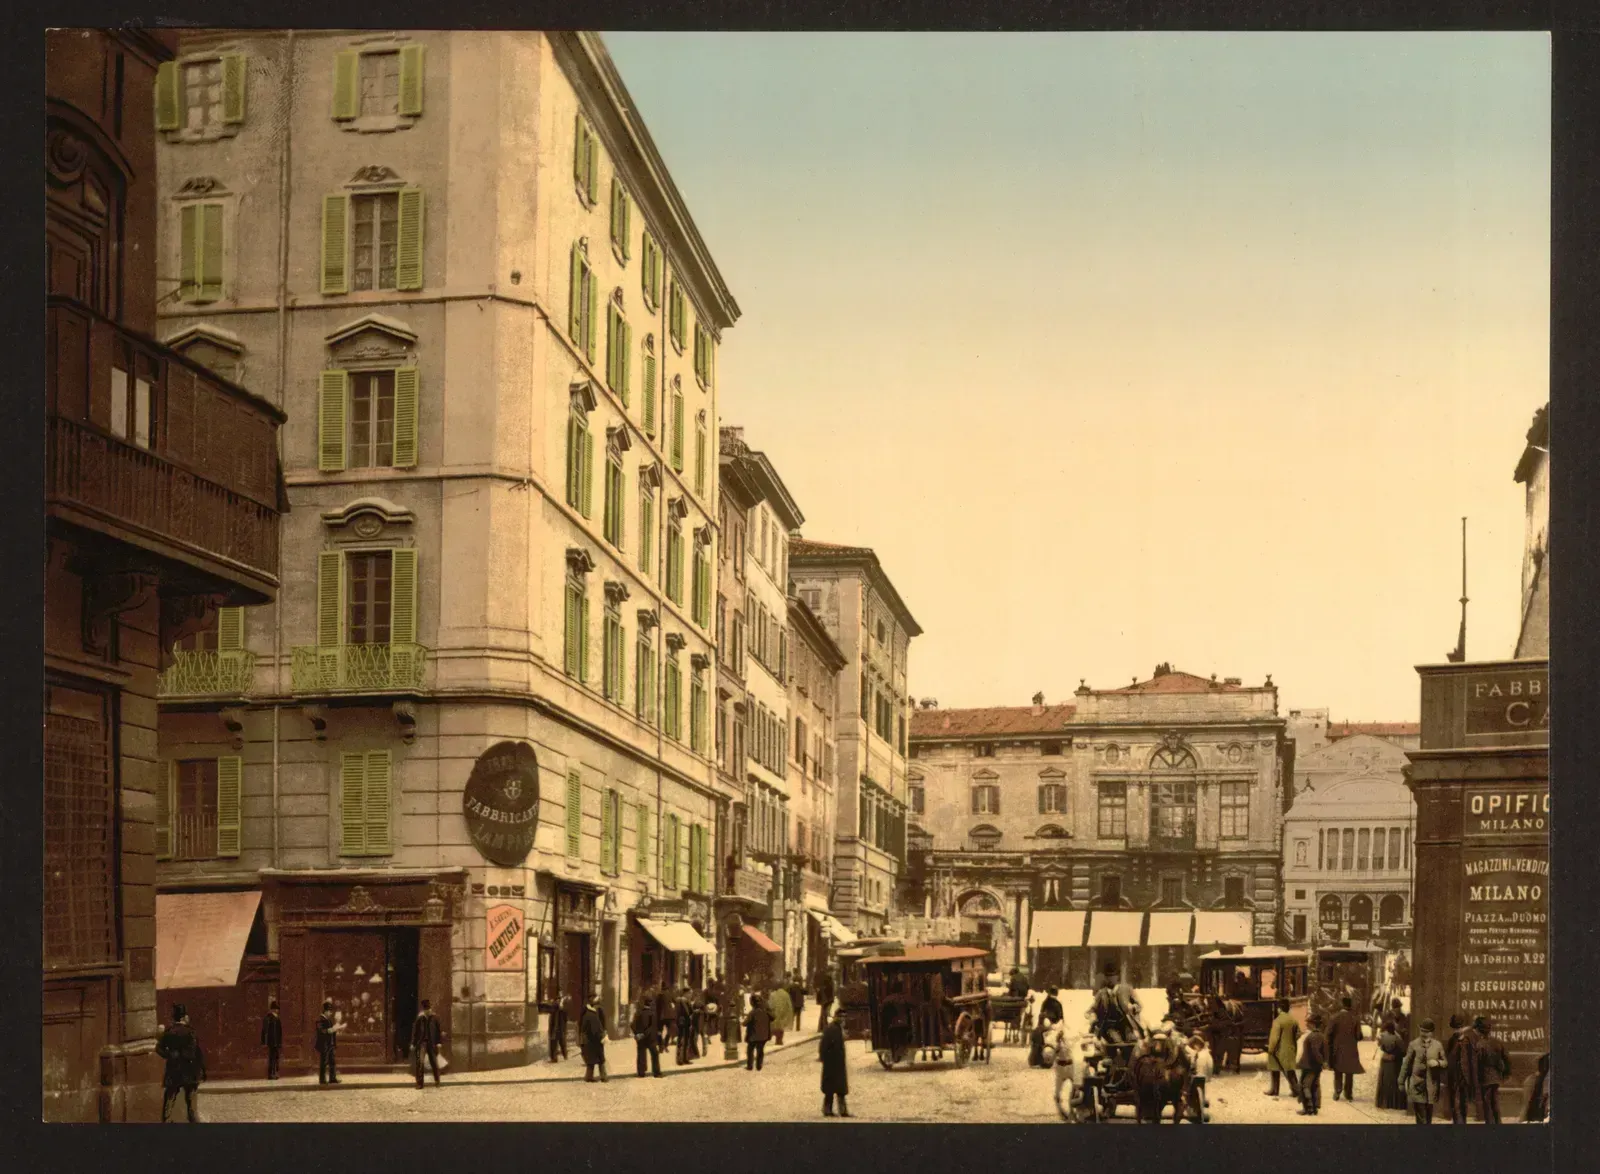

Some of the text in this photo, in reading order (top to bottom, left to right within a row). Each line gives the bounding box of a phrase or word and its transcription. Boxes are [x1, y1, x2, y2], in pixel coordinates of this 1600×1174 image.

[1475, 680, 1541, 697] FABB
[1480, 818, 1544, 830] MILANO
[1465, 858, 1512, 876] MAGAZZINI
[1470, 885, 1542, 901] MILANO
[1465, 912, 1504, 923] PIAZZA
[488, 916, 521, 960] DENTISTA
[1464, 953, 1481, 965] VIA
[1483, 953, 1521, 964] TORINO
[1461, 980, 1546, 992] SI ESEGUISCONO
[1461, 999, 1544, 1011] ORDINAZIONI
